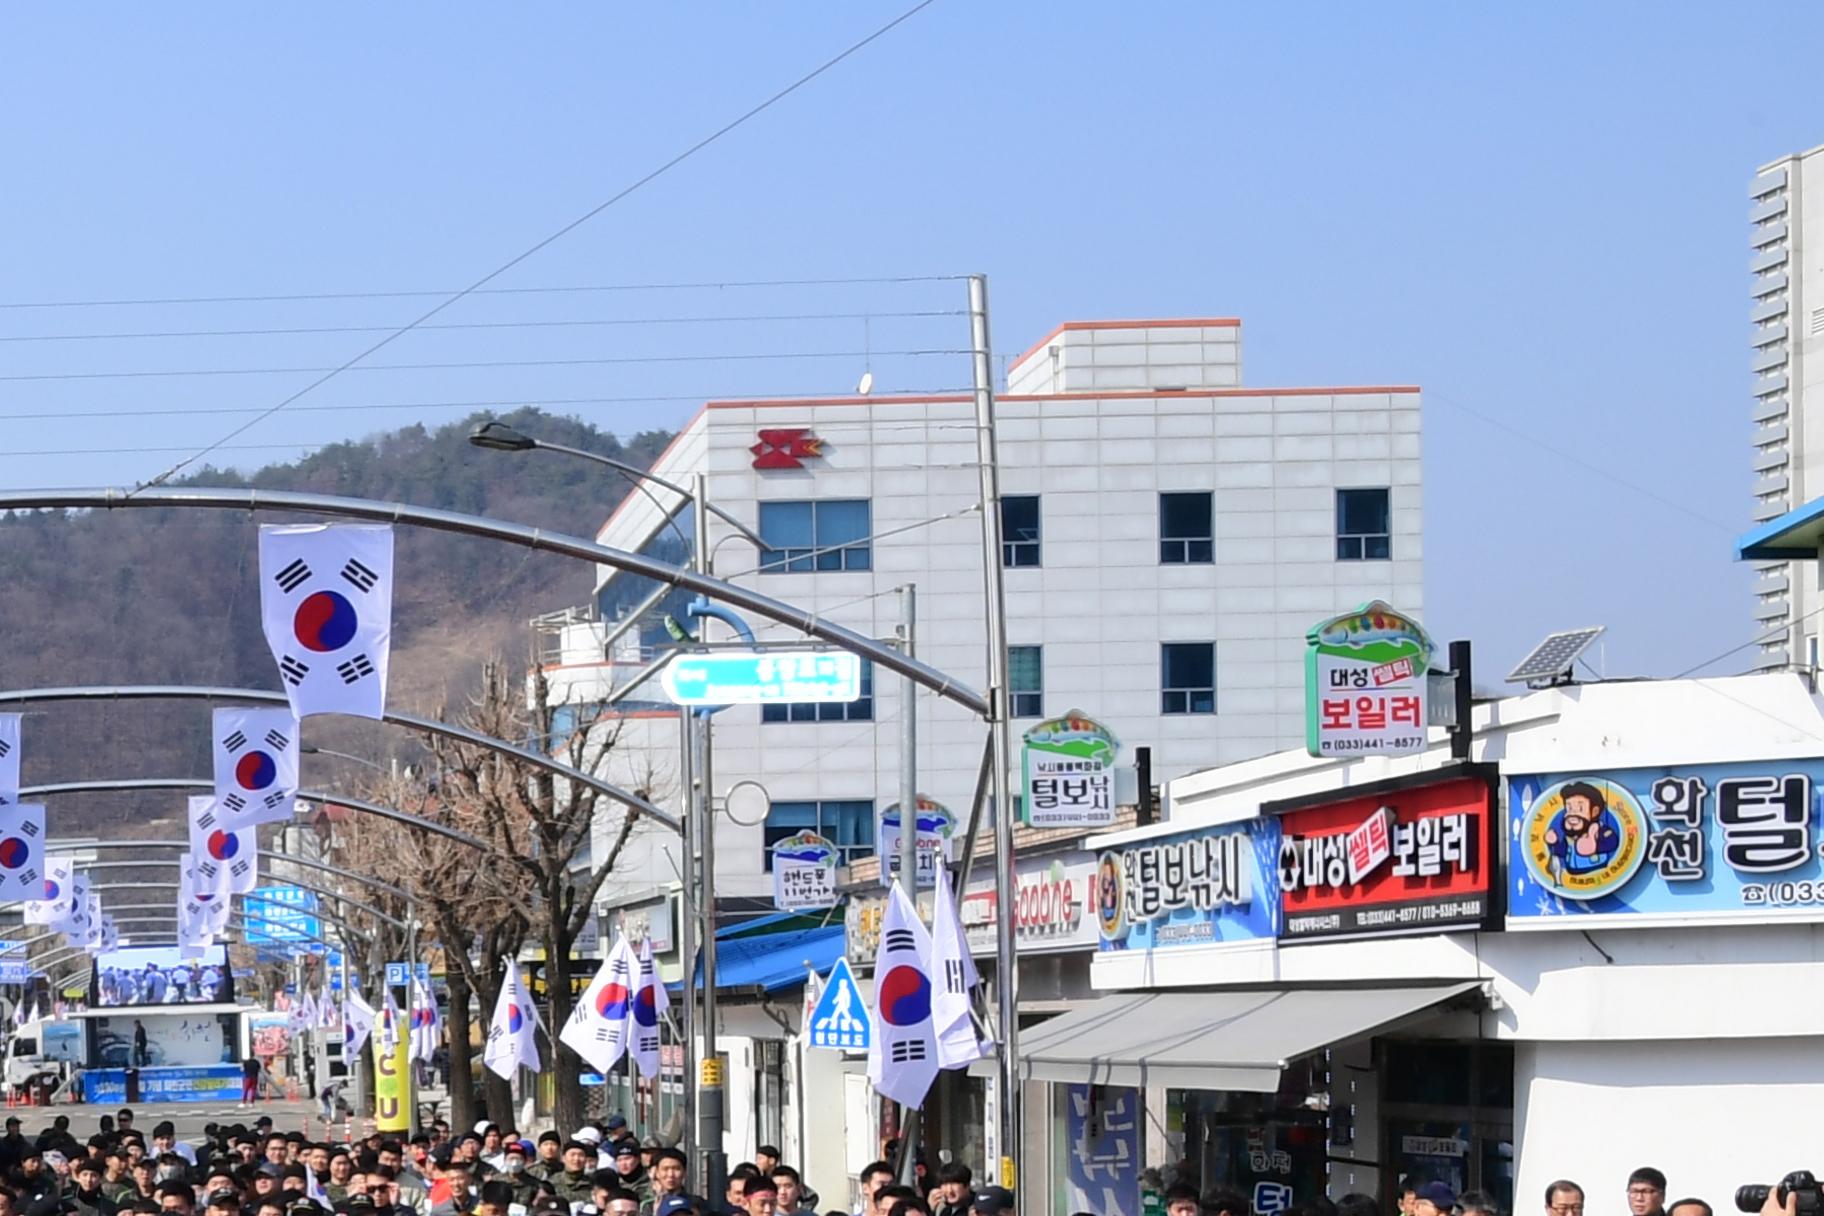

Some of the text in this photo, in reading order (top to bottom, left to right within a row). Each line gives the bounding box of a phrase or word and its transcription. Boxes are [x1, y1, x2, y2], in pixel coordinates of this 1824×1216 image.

[1330, 668, 1368, 687] 대성
[1322, 696, 1421, 729] 보일러
[1032, 779, 1091, 809] 털보
[1303, 832, 1346, 888] 대성
[1391, 812, 1467, 877] 보일러
[1717, 774, 1824, 872] 털
[1139, 833, 1240, 916] 털보낚시
